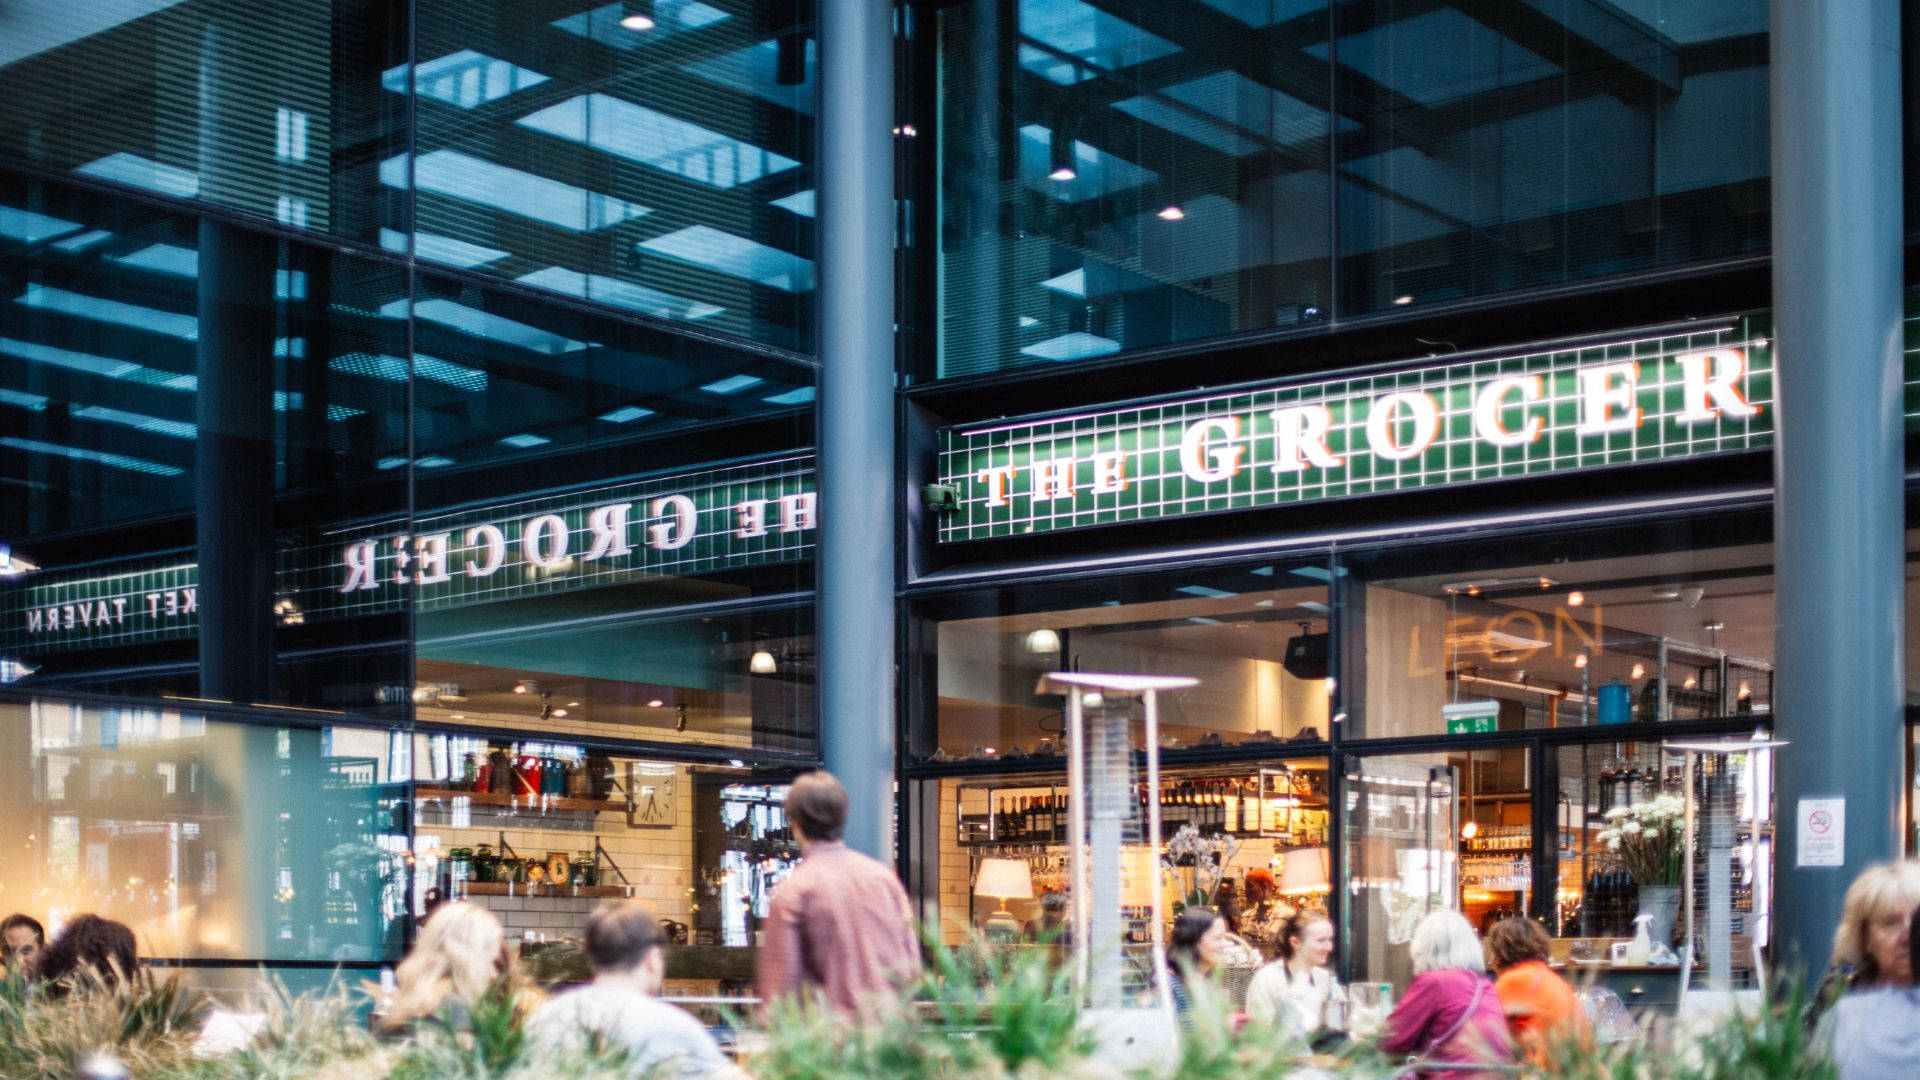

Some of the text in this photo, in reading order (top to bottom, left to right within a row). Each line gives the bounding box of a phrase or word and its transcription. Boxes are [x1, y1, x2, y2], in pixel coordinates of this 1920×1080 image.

[977, 347, 1763, 508] THE GROCER
[1408, 604, 1604, 679] LEON
